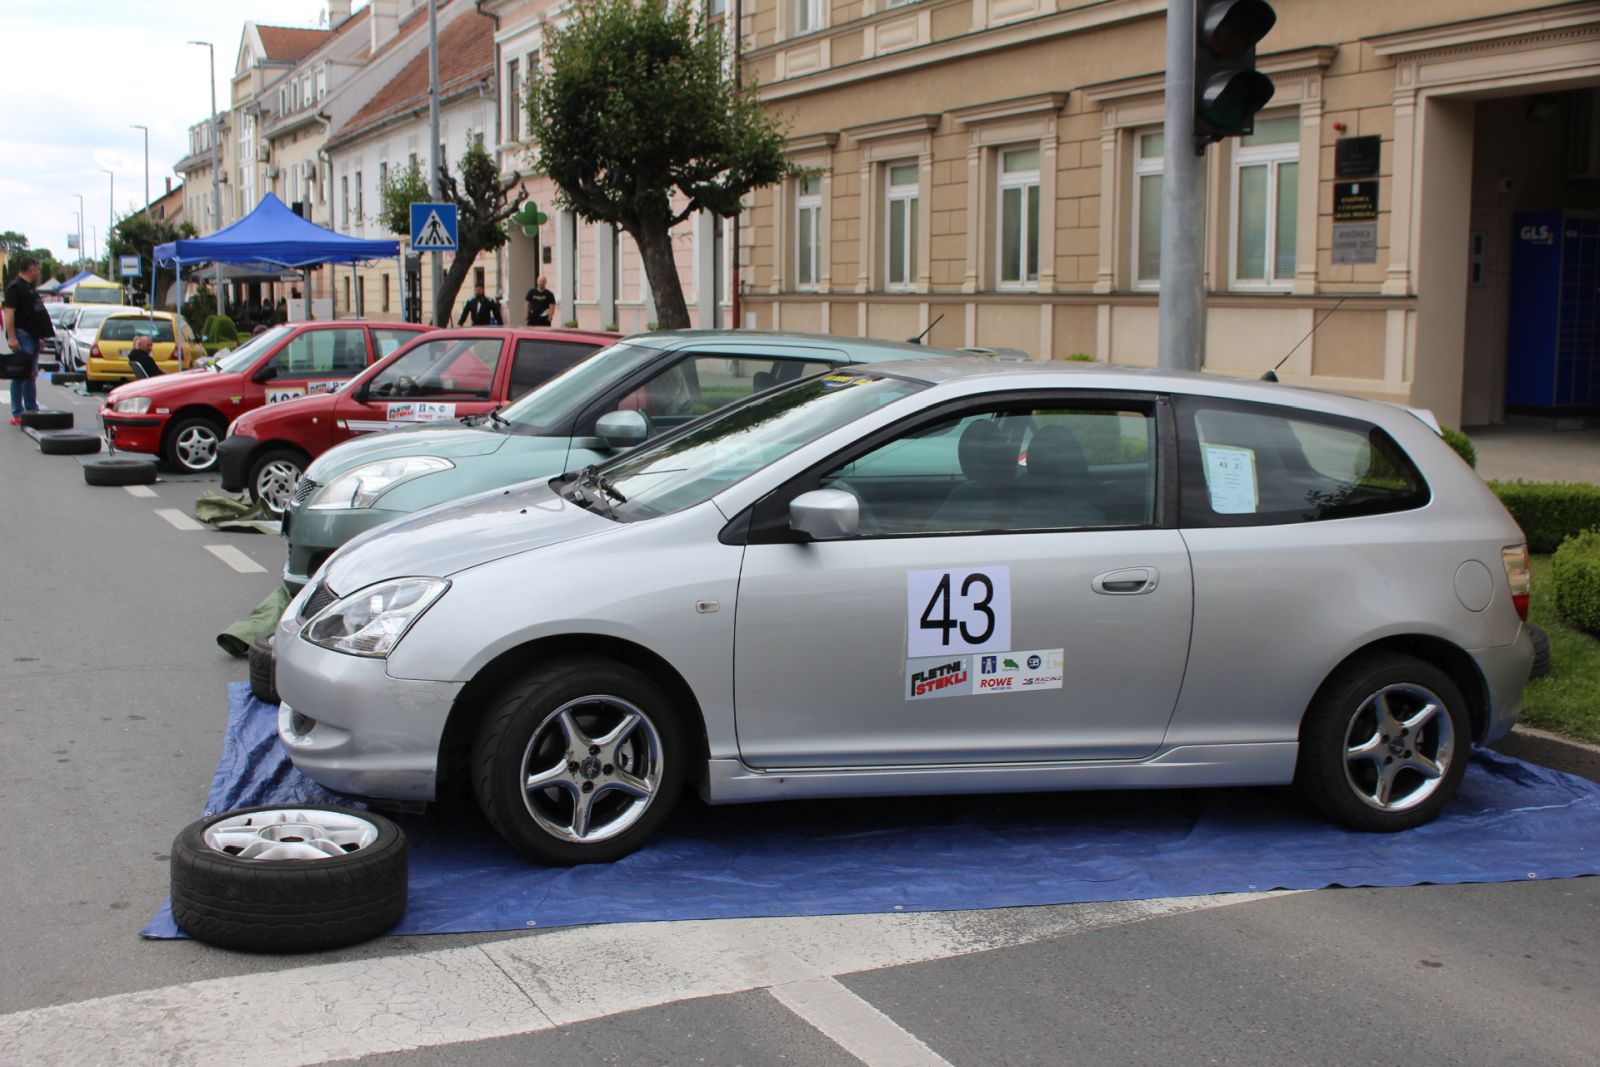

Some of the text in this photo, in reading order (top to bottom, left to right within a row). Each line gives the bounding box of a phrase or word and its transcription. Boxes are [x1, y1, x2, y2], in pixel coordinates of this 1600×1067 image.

[1521, 226, 1549, 240] GLS
[920, 573, 995, 645] 43
[916, 671, 967, 695] STEKLI
[980, 677, 1013, 688] ROWE
